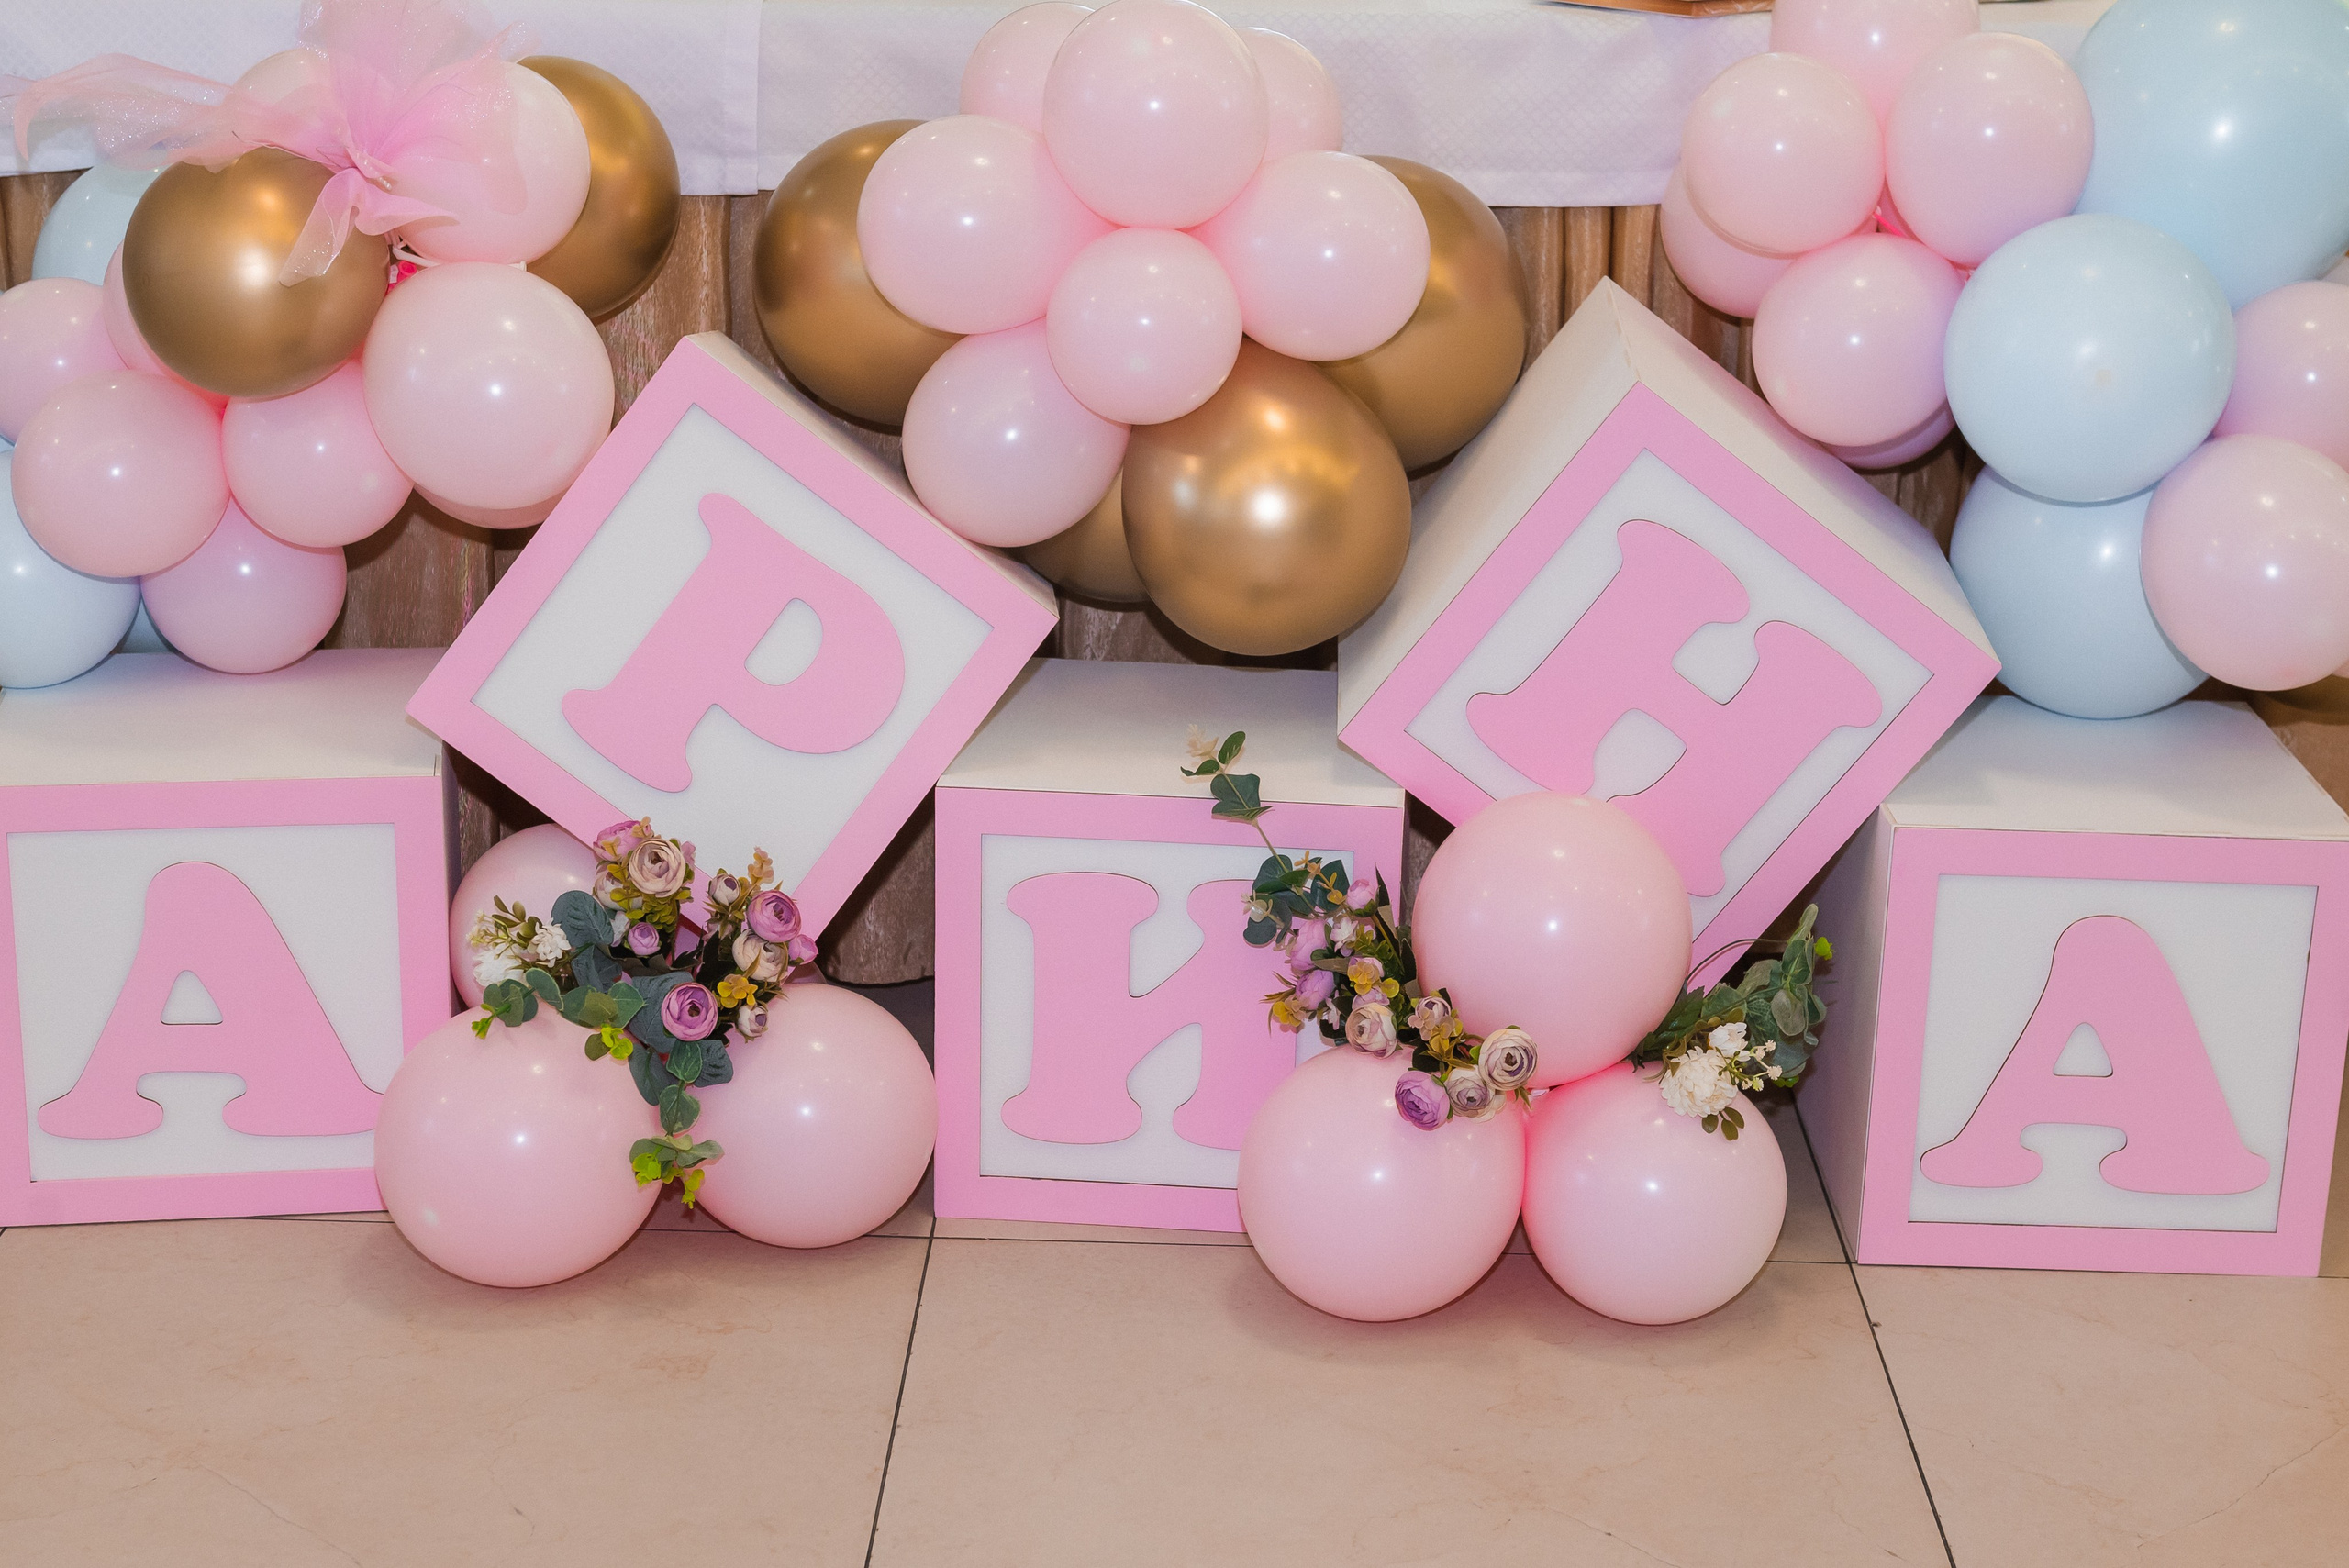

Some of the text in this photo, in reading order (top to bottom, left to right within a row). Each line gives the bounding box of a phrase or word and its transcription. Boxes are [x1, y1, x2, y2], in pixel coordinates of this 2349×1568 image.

[561, 492, 906, 794] Р
[37, 861, 385, 1140] А
[1920, 915, 2271, 1195] А
